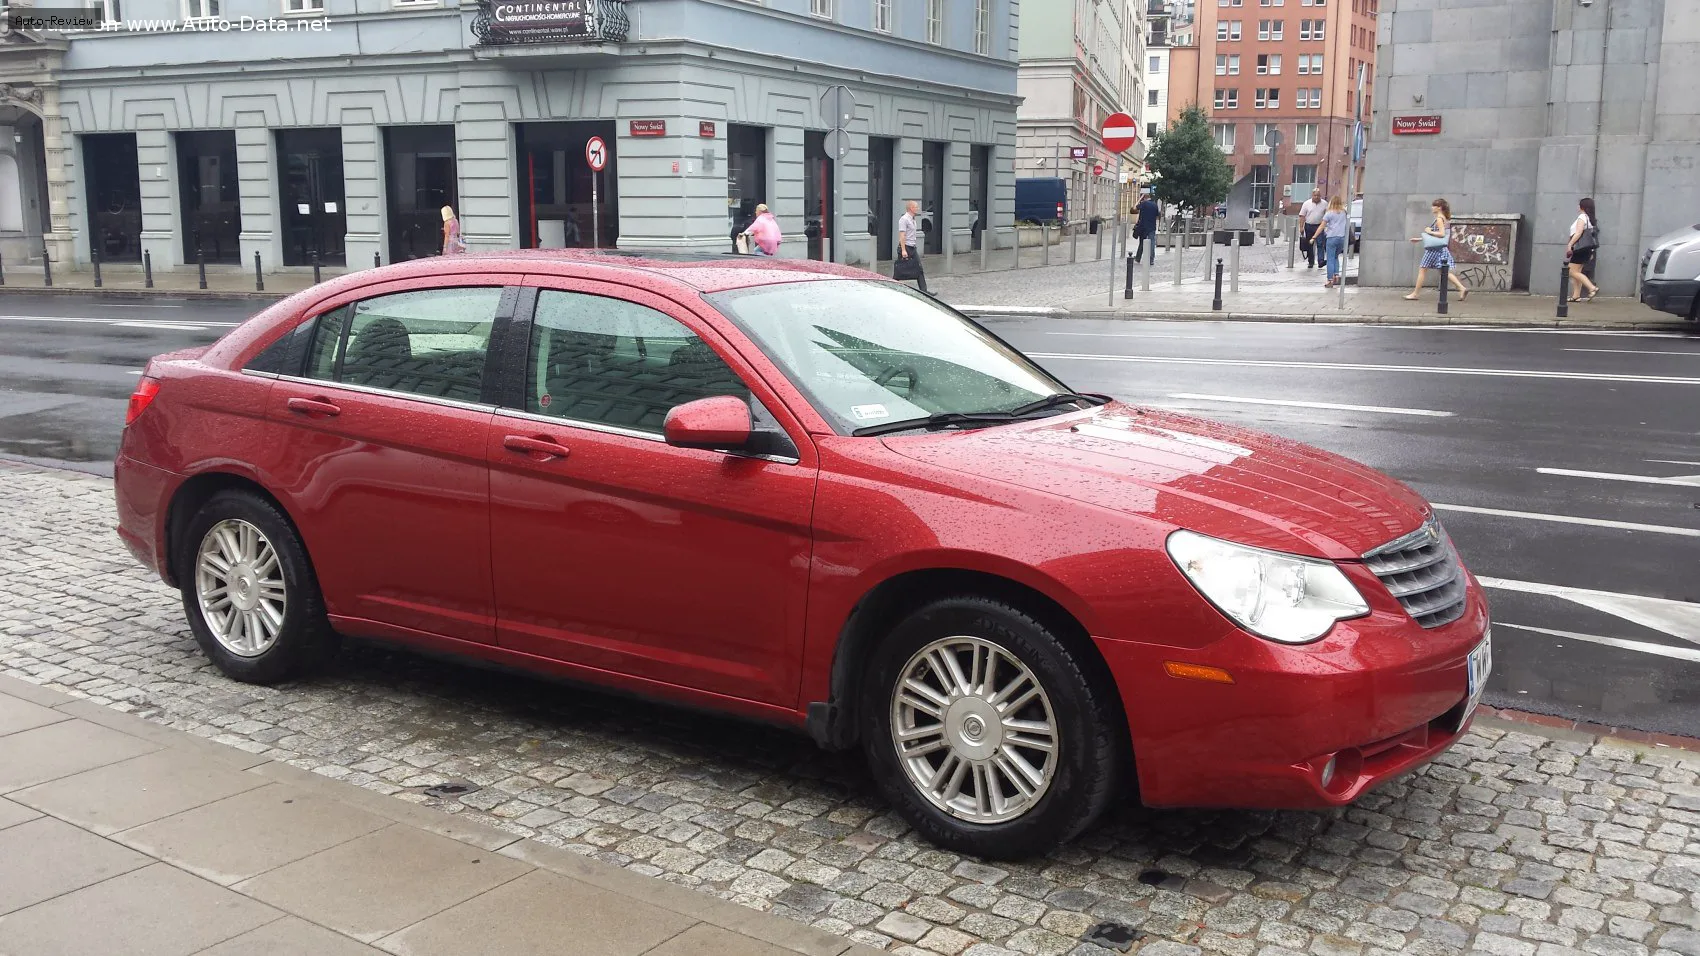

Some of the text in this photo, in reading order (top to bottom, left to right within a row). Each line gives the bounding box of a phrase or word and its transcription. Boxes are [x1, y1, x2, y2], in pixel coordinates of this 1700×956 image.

[495, 2, 581, 21] CONTINENTAL
[634, 121, 663, 131] Nowy Świat
[1396, 118, 1436, 129] Nowy Świat
